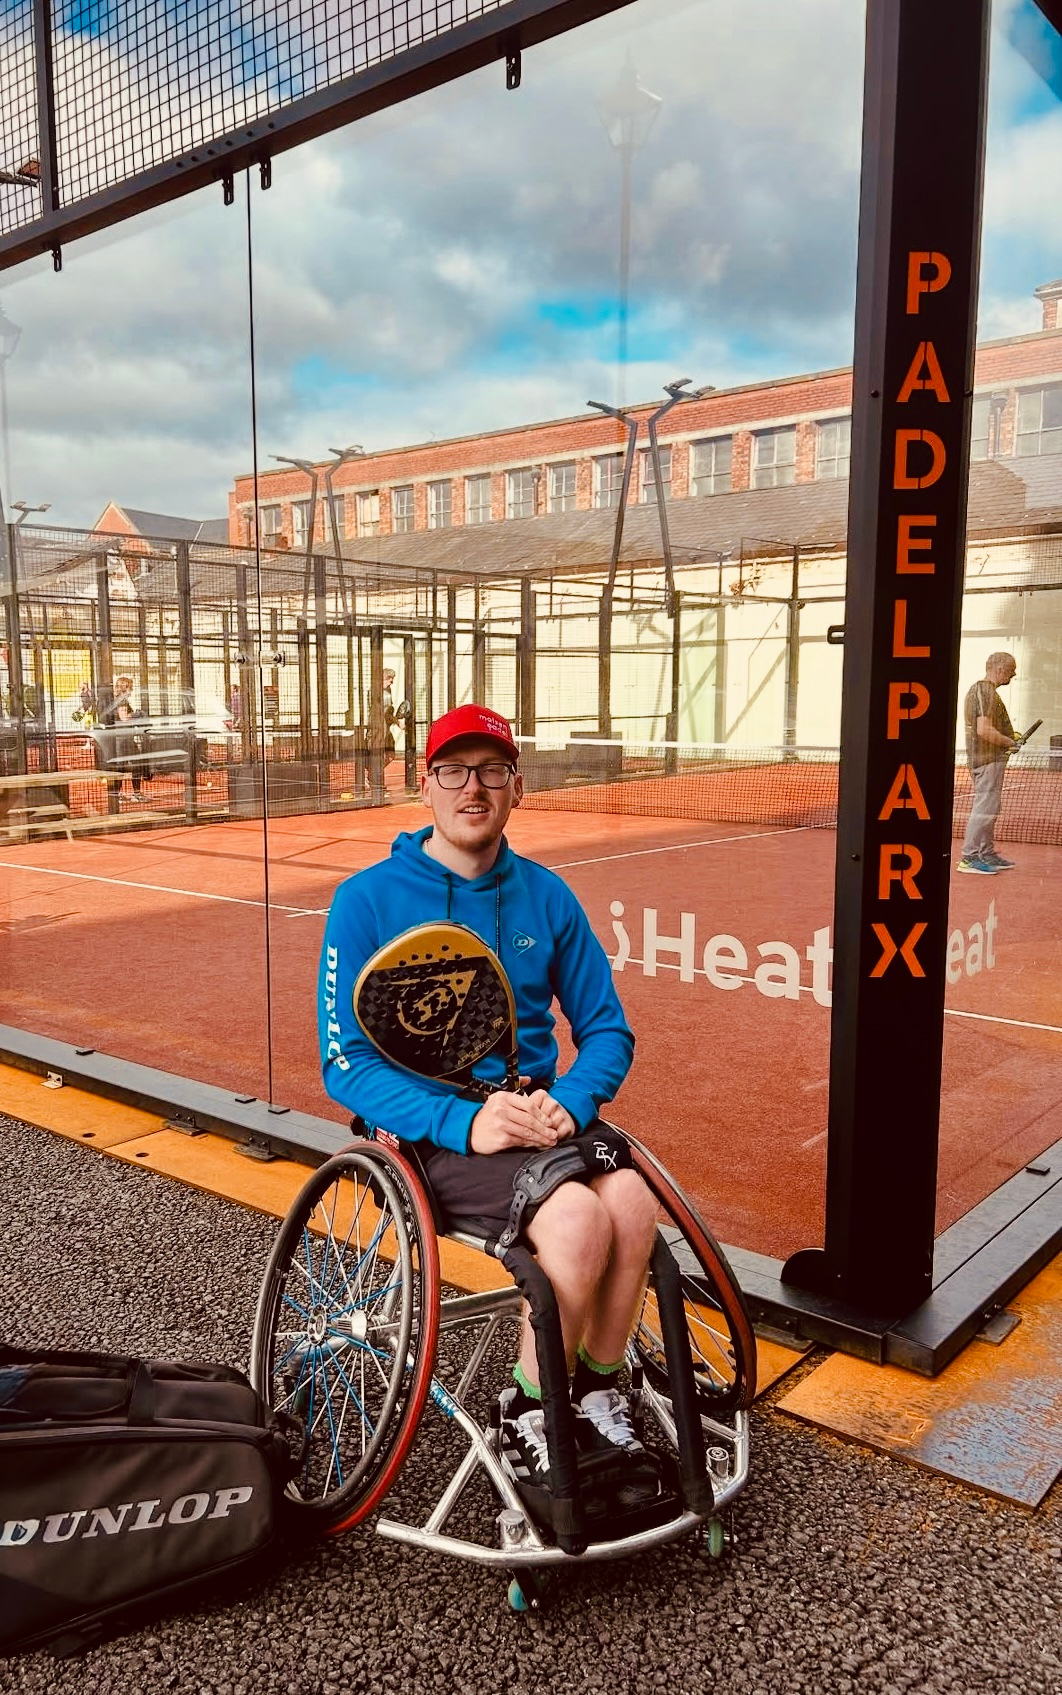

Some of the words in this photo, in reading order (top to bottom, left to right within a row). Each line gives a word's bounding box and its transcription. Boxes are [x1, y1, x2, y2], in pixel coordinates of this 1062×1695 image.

[869, 252, 951, 978] PADELPARX
[946, 897, 998, 984] eat
[0, 1486, 253, 1546] DUNLOP
